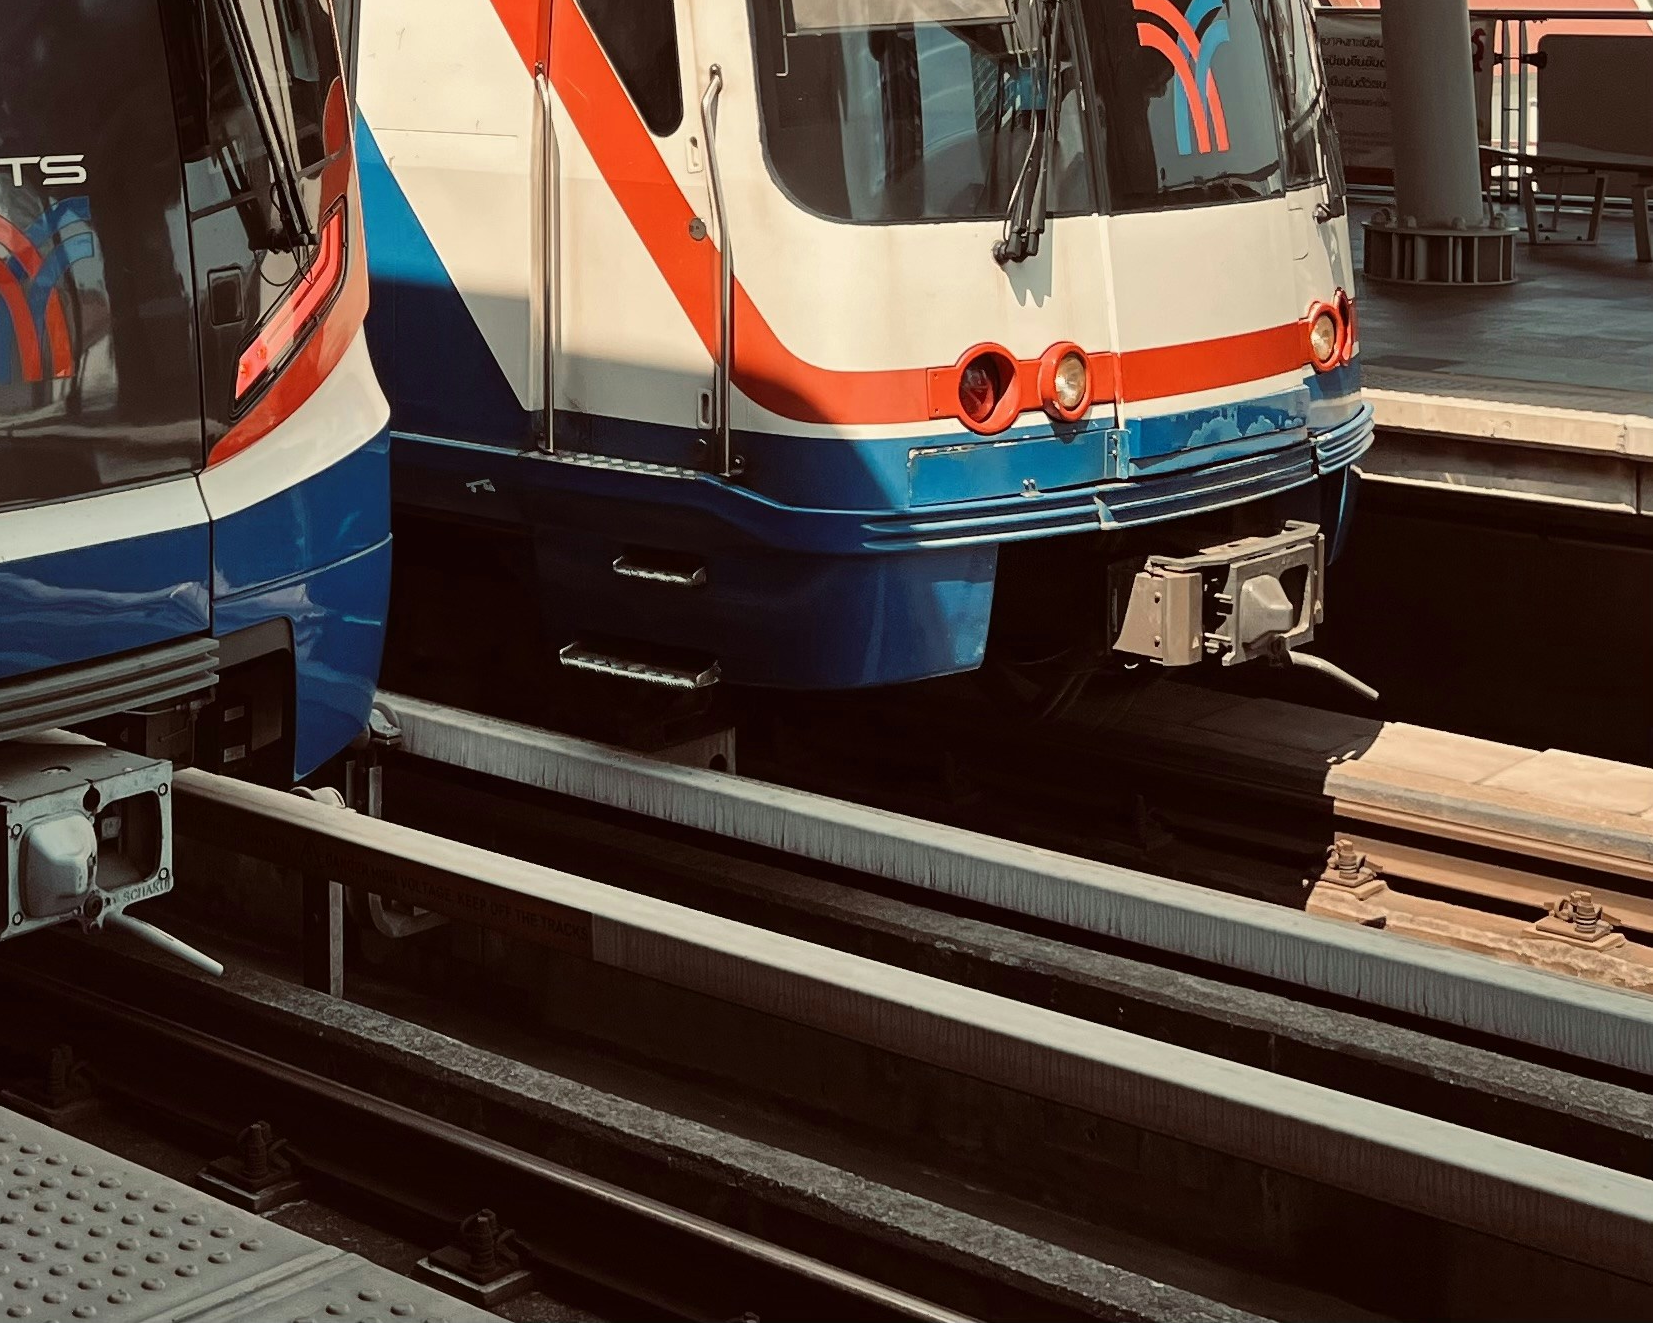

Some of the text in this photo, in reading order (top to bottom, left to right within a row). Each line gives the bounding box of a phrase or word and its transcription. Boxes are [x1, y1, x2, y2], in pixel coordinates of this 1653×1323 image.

[401, 874, 452, 903] VOLTAGE
[457, 890, 486, 912] KEEP
[515, 908, 540, 928] THE
[540, 914, 589, 942] TRACKS
